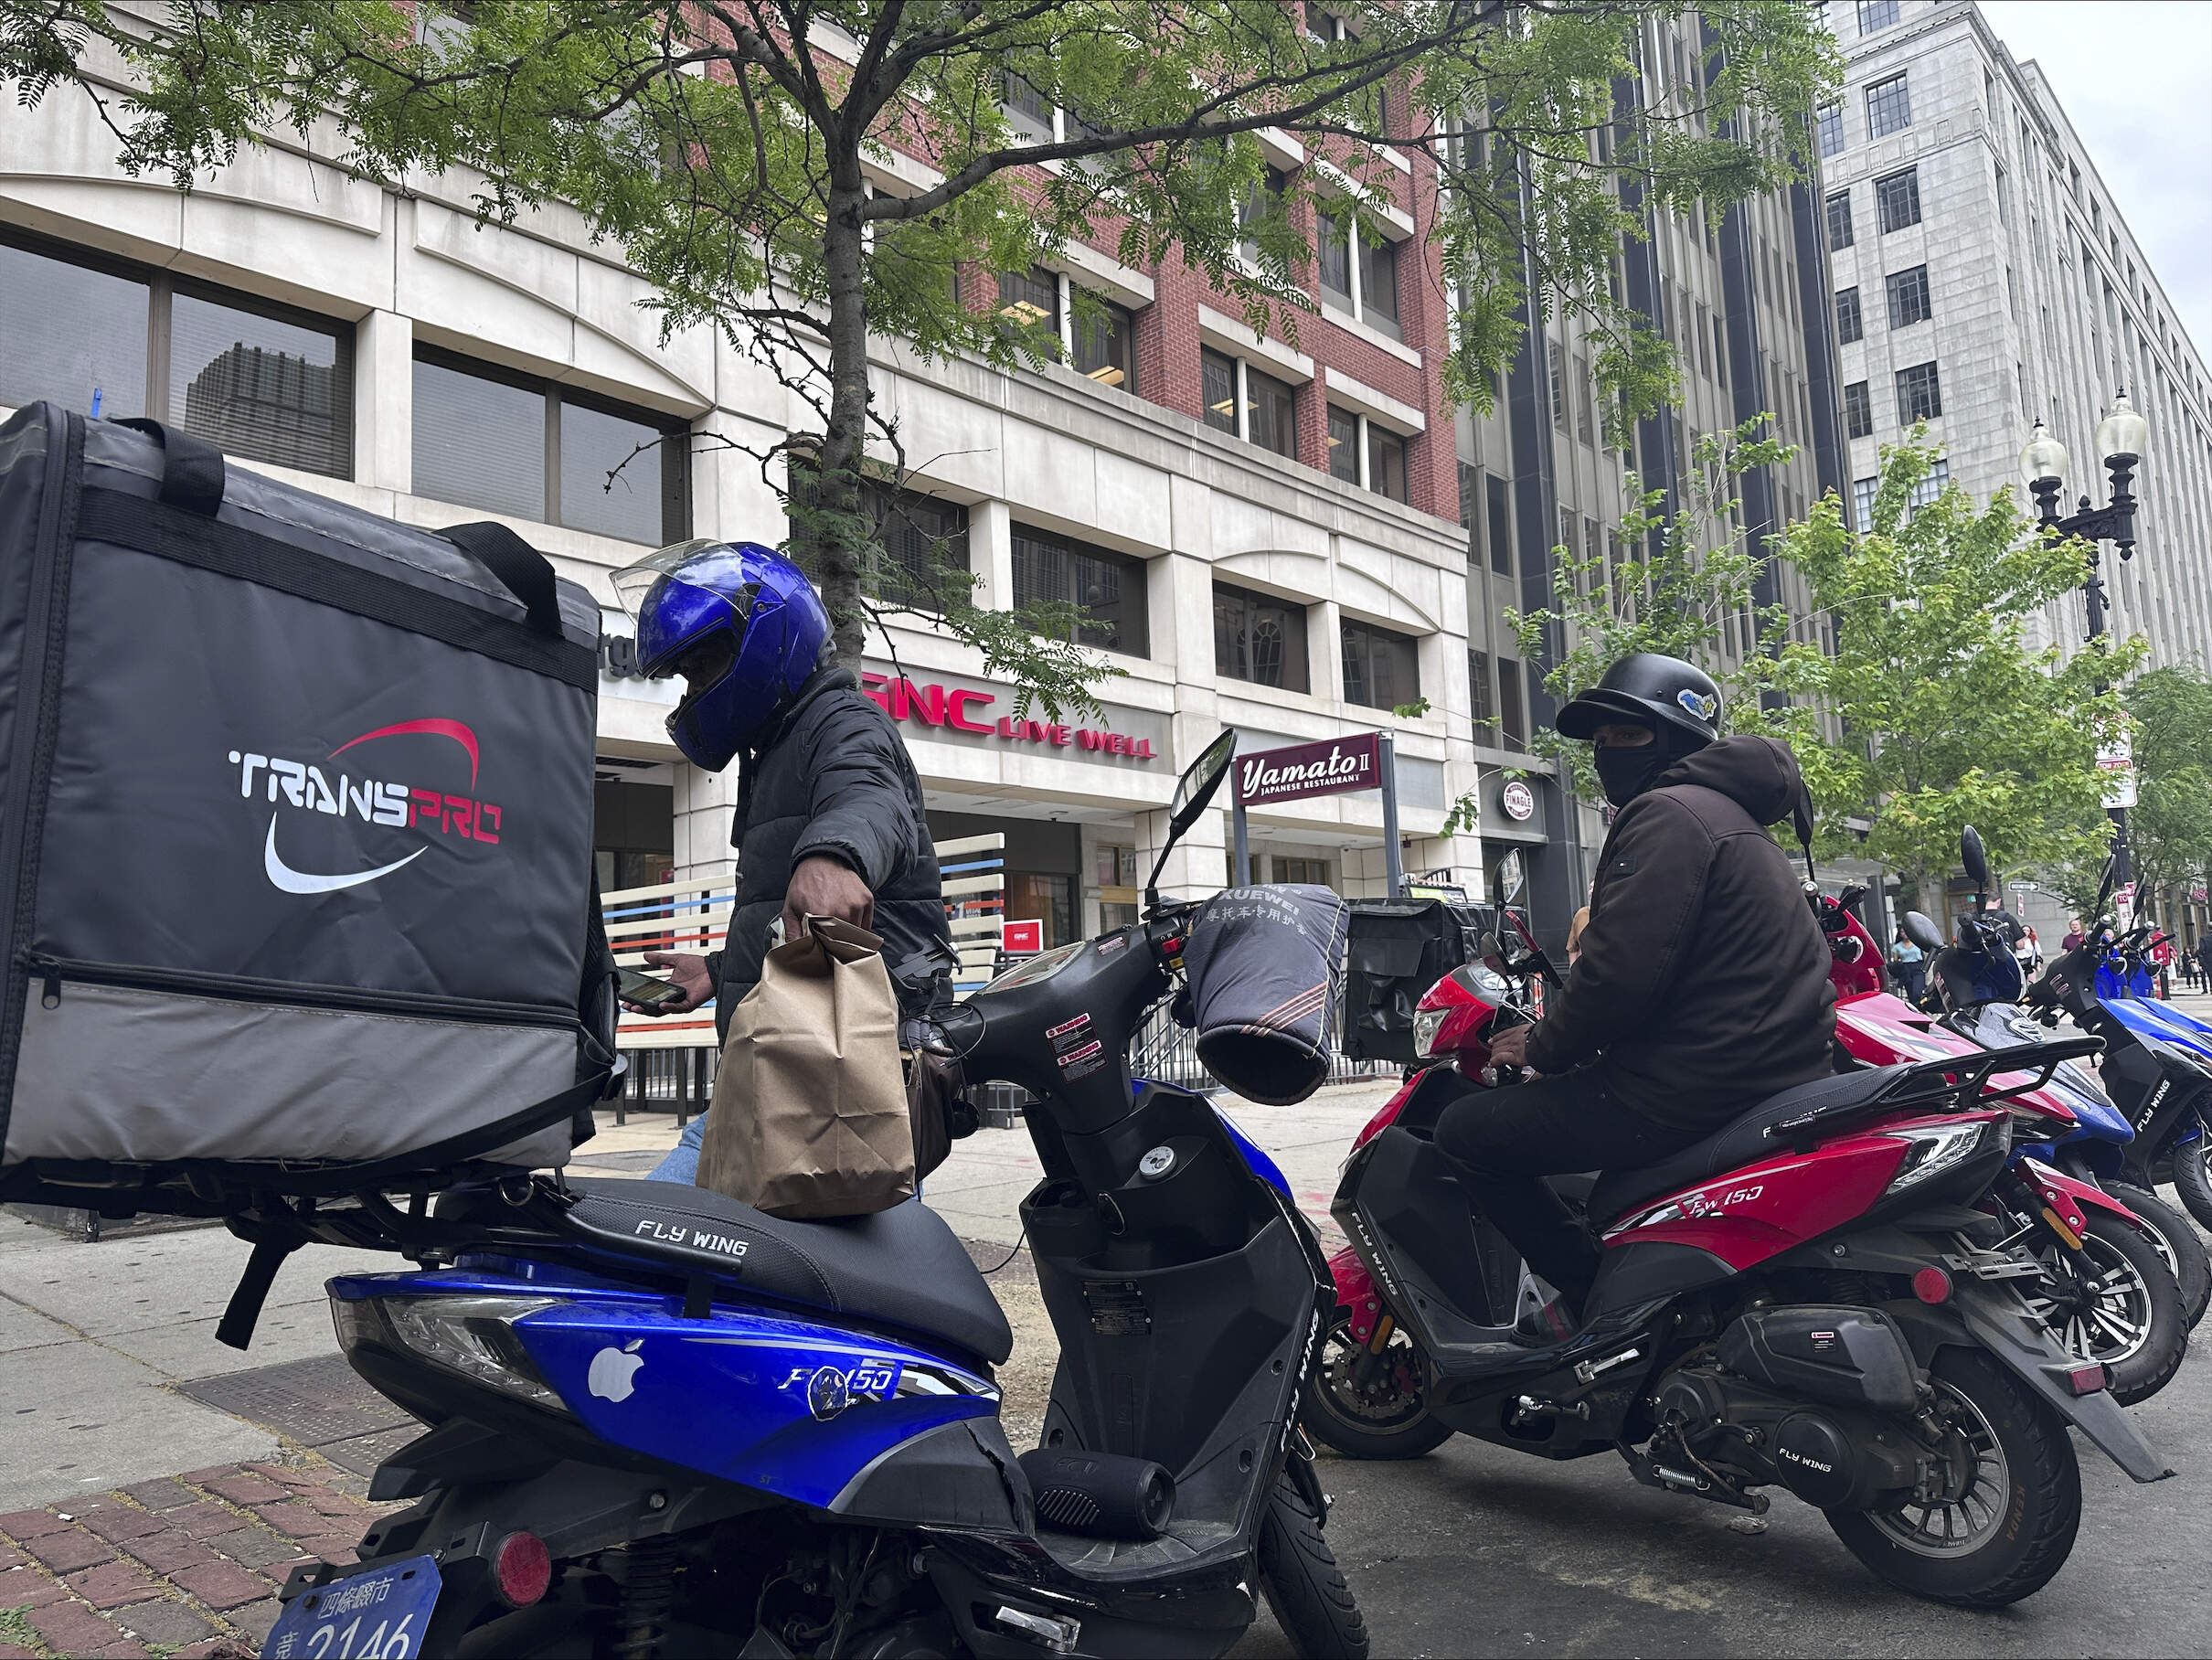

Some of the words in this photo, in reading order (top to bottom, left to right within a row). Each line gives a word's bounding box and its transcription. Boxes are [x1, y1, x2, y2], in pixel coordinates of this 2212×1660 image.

[999, 716, 1072, 747] LIVE
[1076, 729, 1158, 759] WELL
[1242, 745, 1356, 798] Yamato
[1359, 753, 1370, 771] II
[1260, 782, 1301, 796] JAPANESE
[1304, 773, 1360, 789] RESTAURANT
[228, 750, 503, 845] TRANSPRO
[1505, 794, 1532, 808] FINAGLE
[2137, 1108, 2154, 1133] FLY
[2151, 1080, 2171, 1108] WING
[635, 1219, 686, 1242] FLY
[693, 1231, 749, 1256] WING
[1352, 1212, 1373, 1247] FLY
[1372, 1251, 1398, 1295] WING
[1779, 1448, 1800, 1462] FLY
[1802, 1457, 1832, 1473] WING
[307, 1613, 414, 1659] 2146
